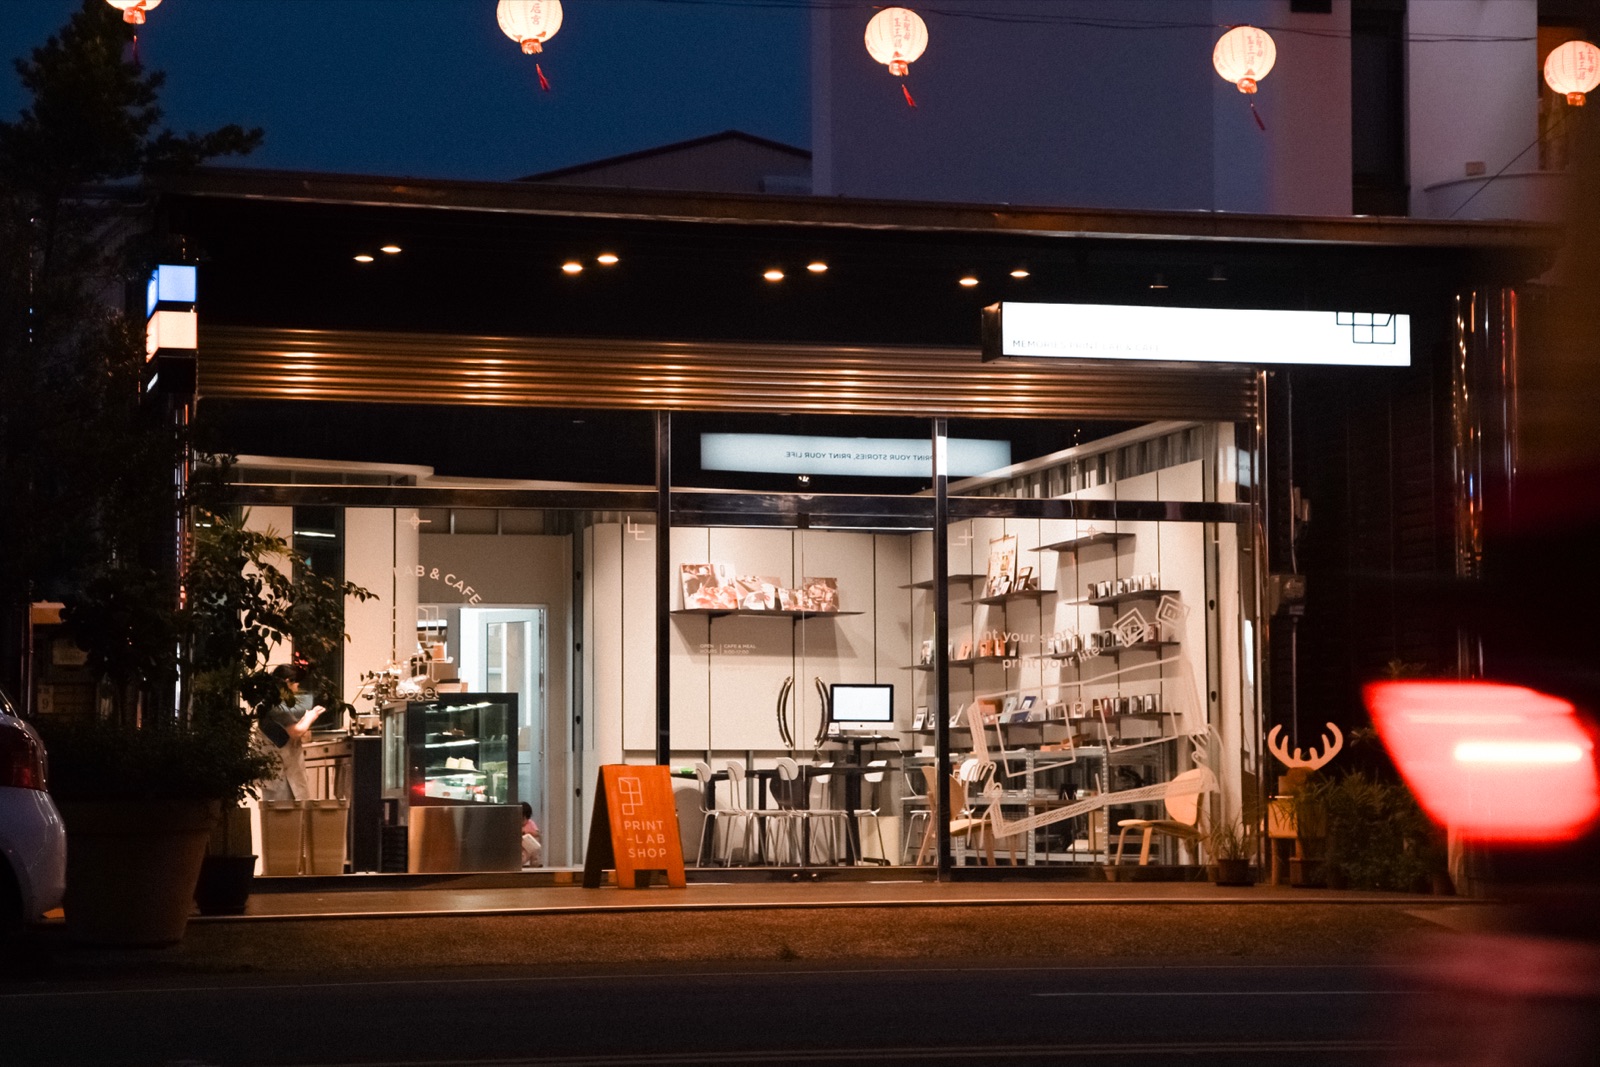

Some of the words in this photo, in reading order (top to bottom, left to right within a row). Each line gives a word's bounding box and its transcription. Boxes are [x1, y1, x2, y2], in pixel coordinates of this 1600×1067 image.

[430, 567, 440, 580] &
[444, 573, 482, 606] CAFE
[1002, 631, 1036, 644] your
[1002, 656, 1037, 671] print
[1042, 656, 1074, 671] your
[623, 820, 664, 831] PRINT
[628, 847, 667, 858] SHOP
